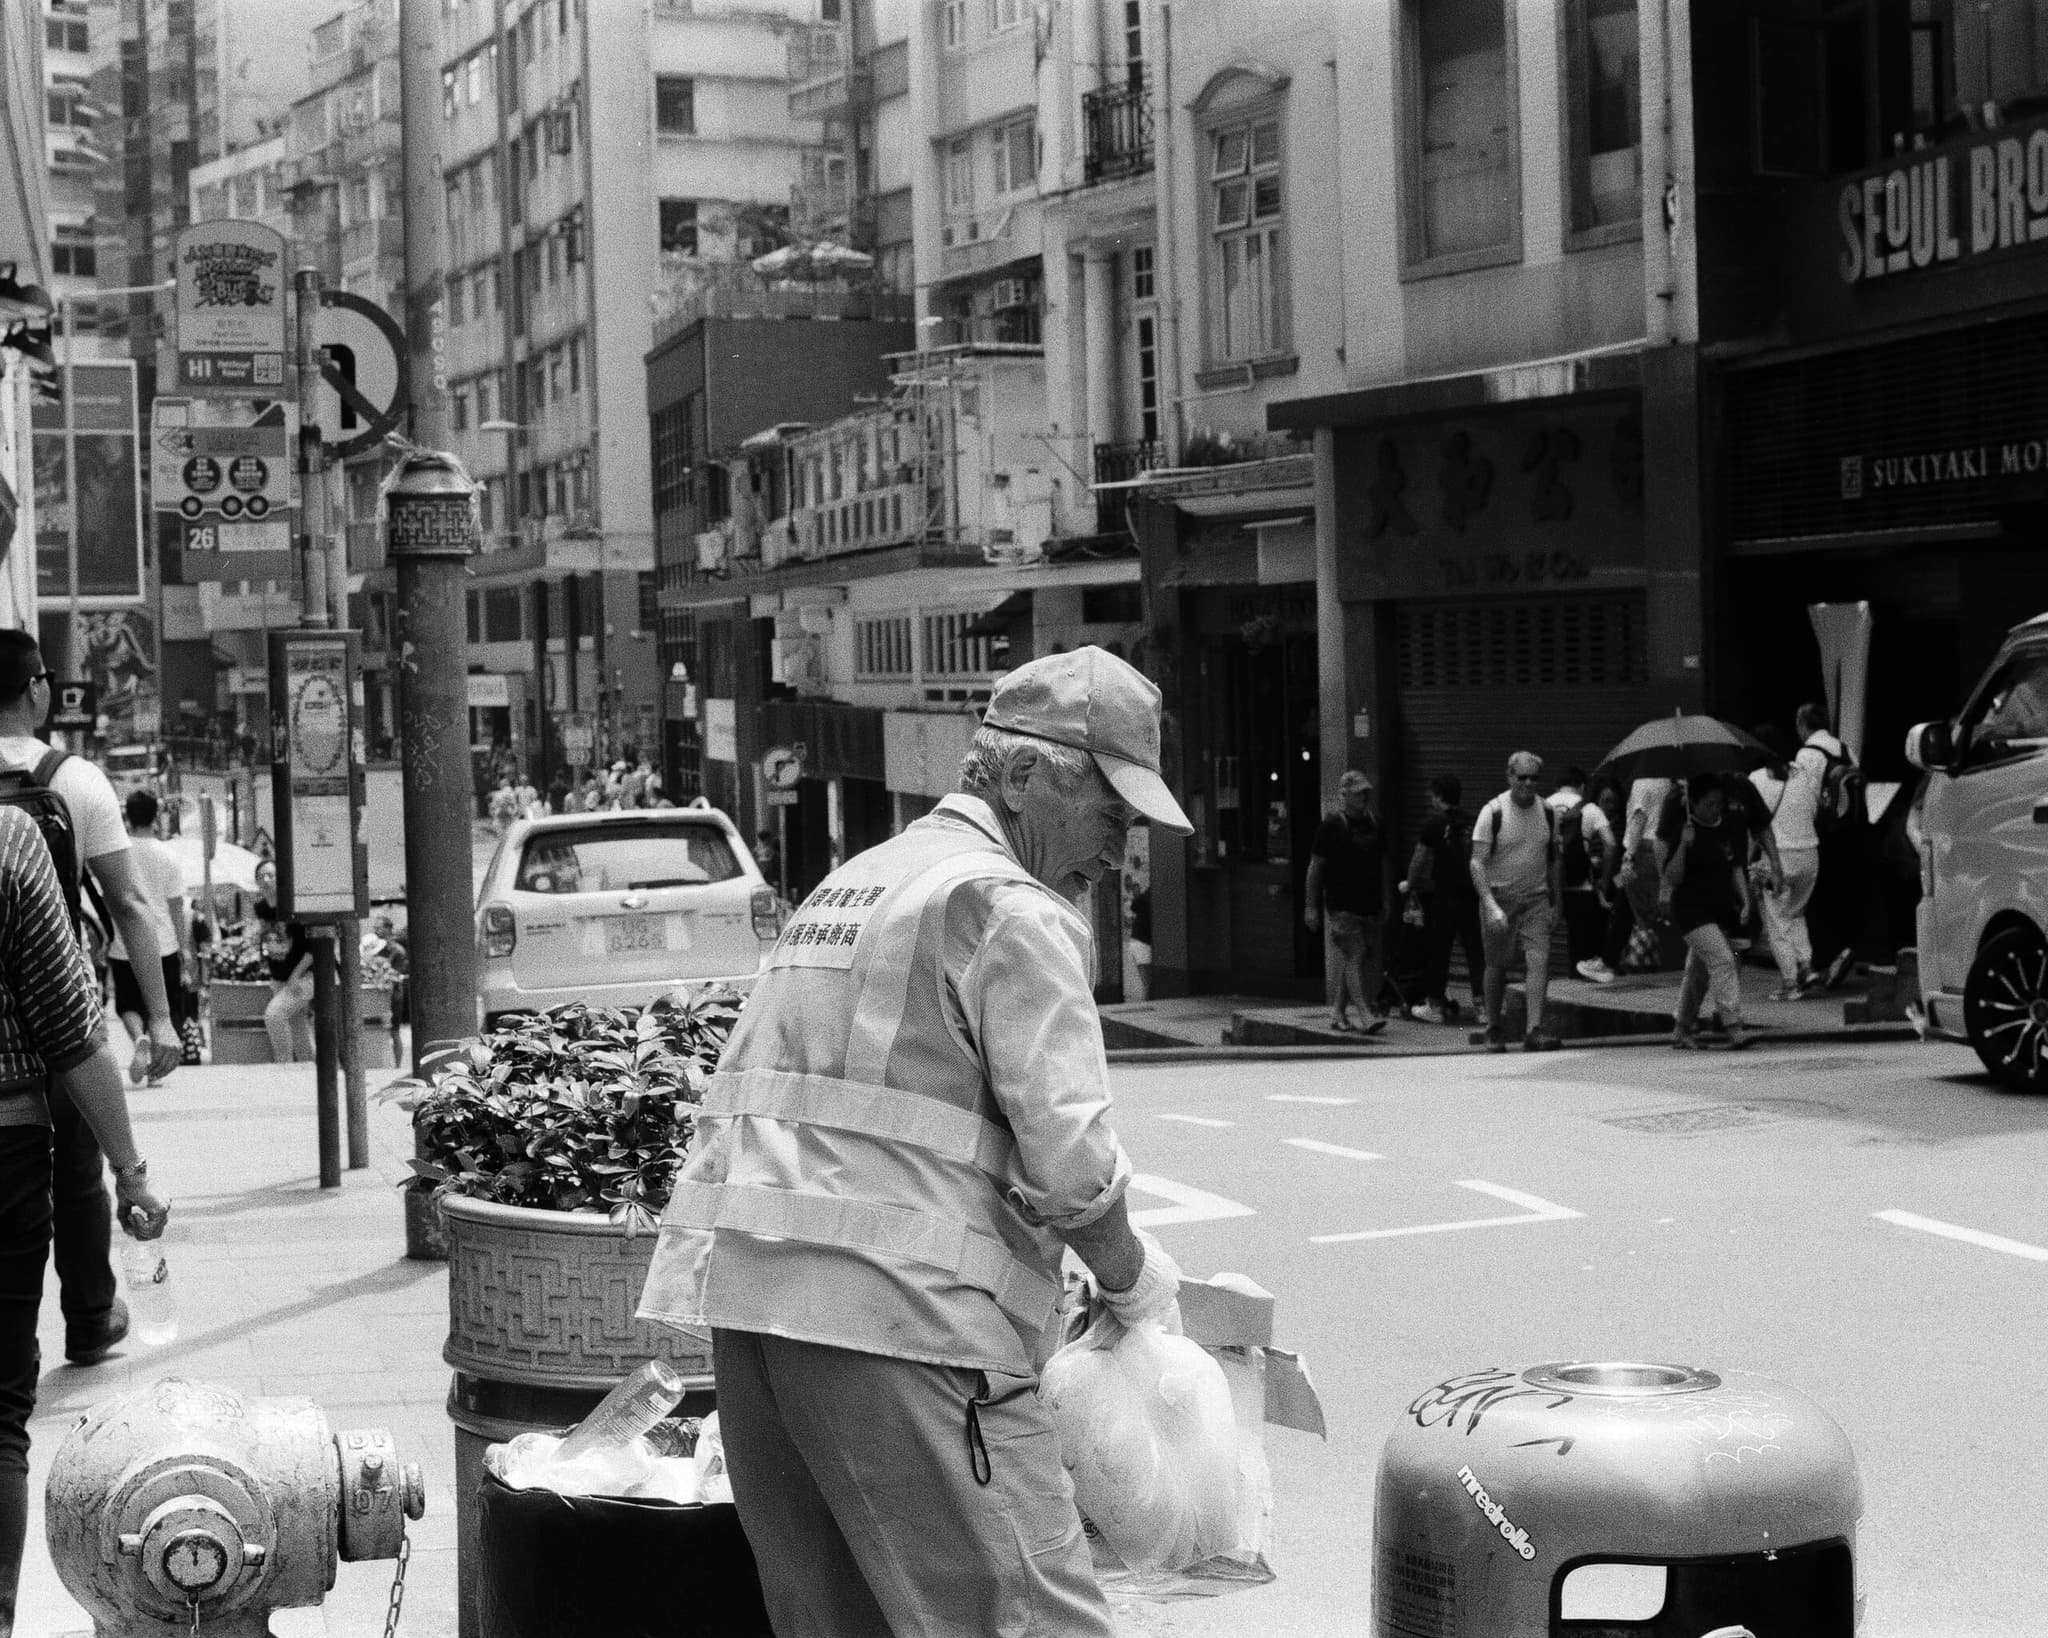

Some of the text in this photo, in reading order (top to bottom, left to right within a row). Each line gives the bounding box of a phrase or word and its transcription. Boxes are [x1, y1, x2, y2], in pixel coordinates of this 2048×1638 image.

[1839, 155, 1959, 284] SEOUL
[1873, 446, 1988, 488] SUKIYAKI
[188, 527, 215, 550] 26
[803, 886, 886, 908] 環境衛生署
